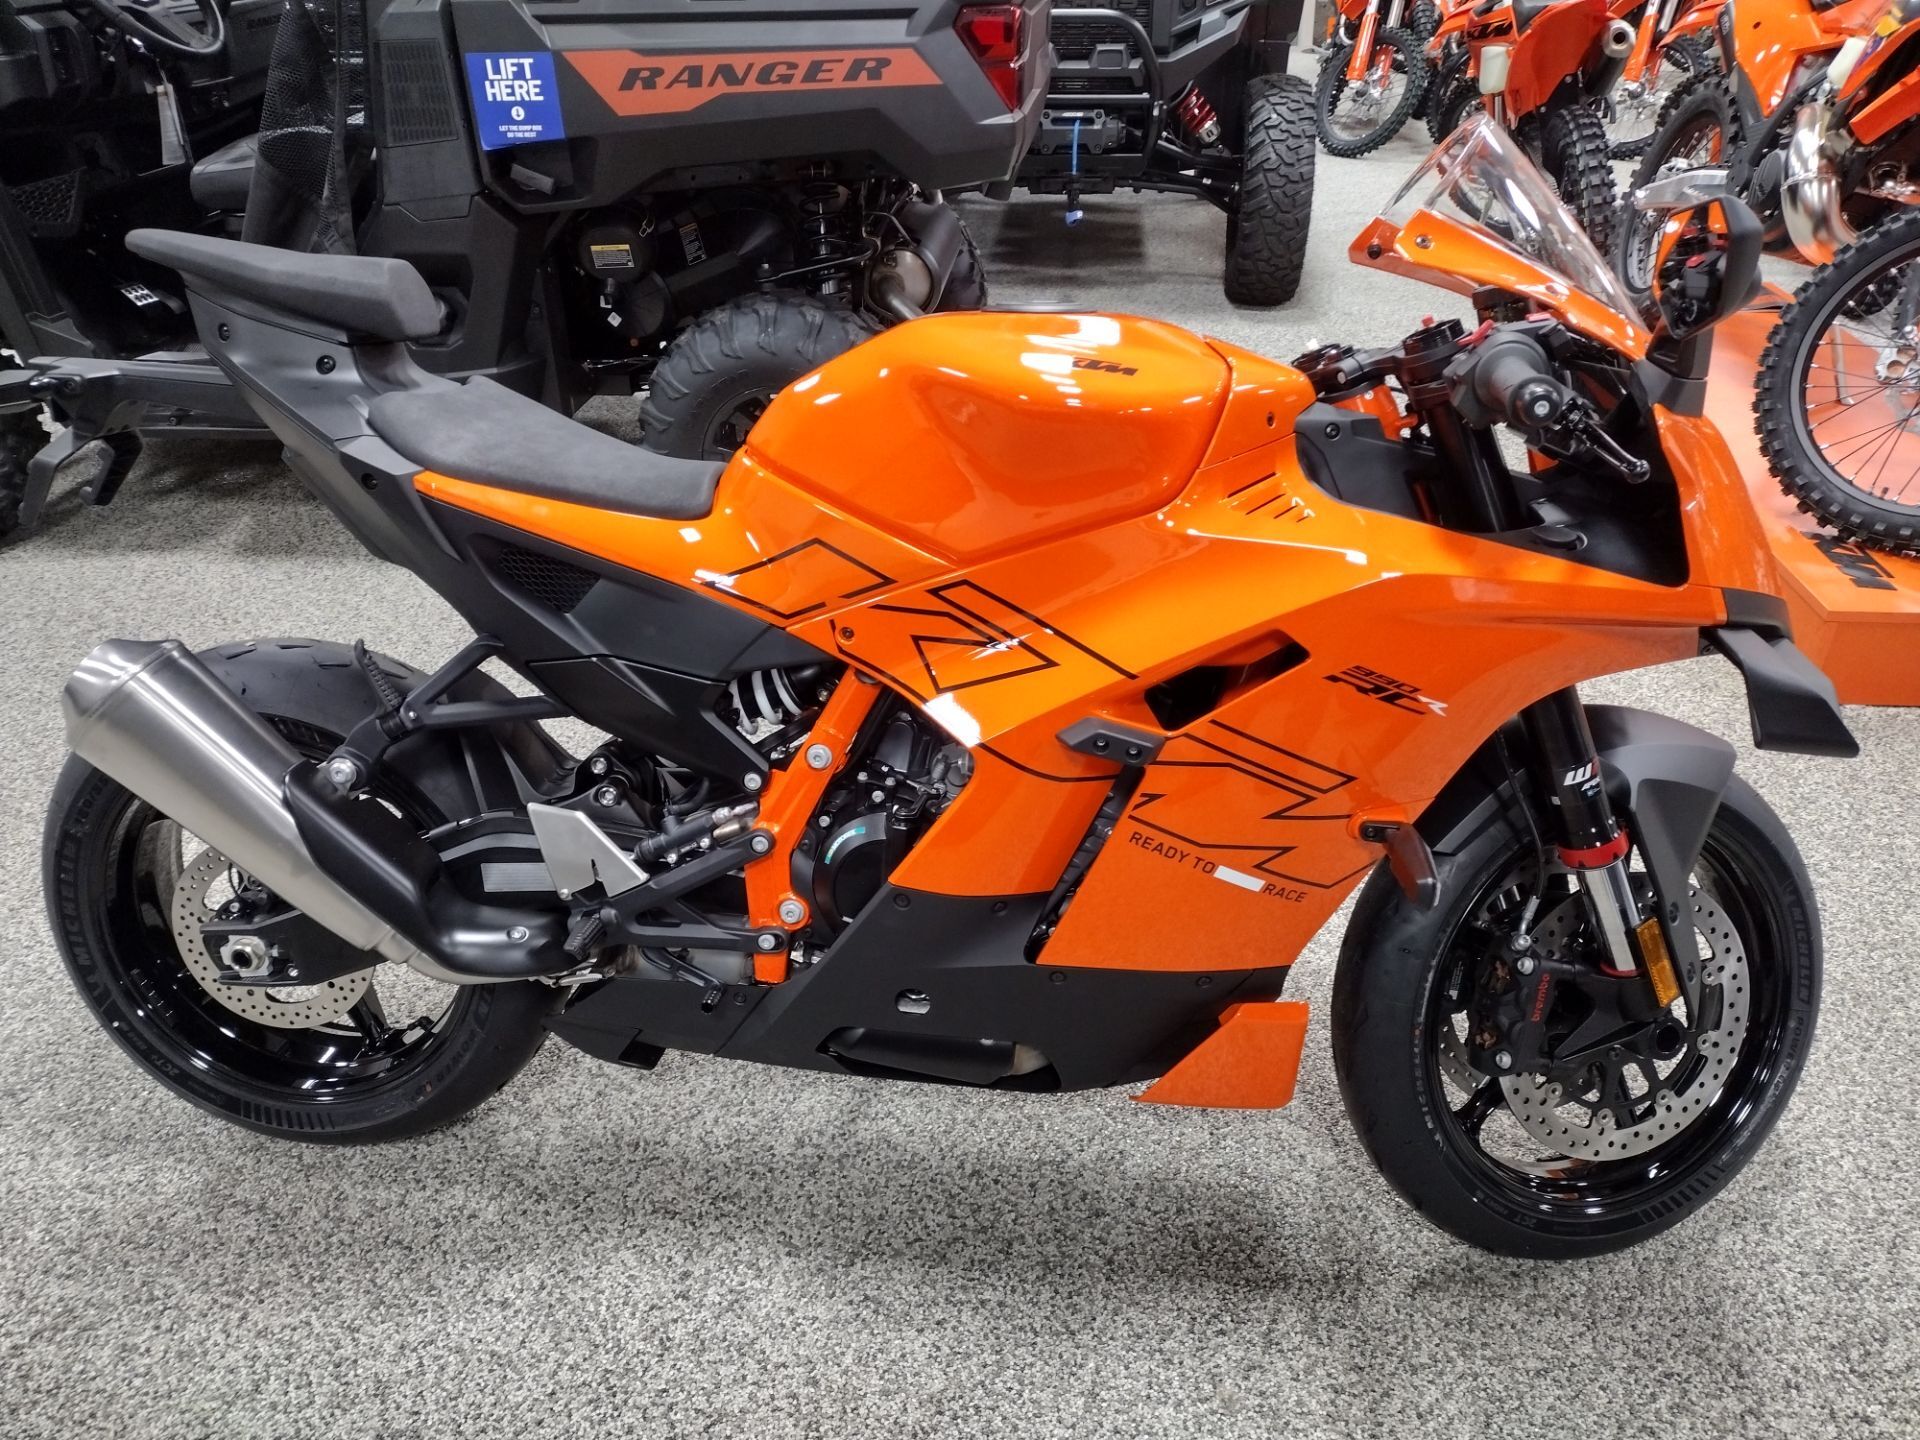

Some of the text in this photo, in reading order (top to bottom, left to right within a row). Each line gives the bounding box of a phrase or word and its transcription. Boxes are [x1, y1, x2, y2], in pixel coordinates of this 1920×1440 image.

[485, 58, 533, 80] LIFT
[618, 57, 892, 91] RANGER
[484, 80, 544, 101] HERE
[1129, 831, 1308, 904] READY TO RACE
[1791, 906, 1811, 1005] MICHELIN
[1531, 973, 1550, 1023] brembo
